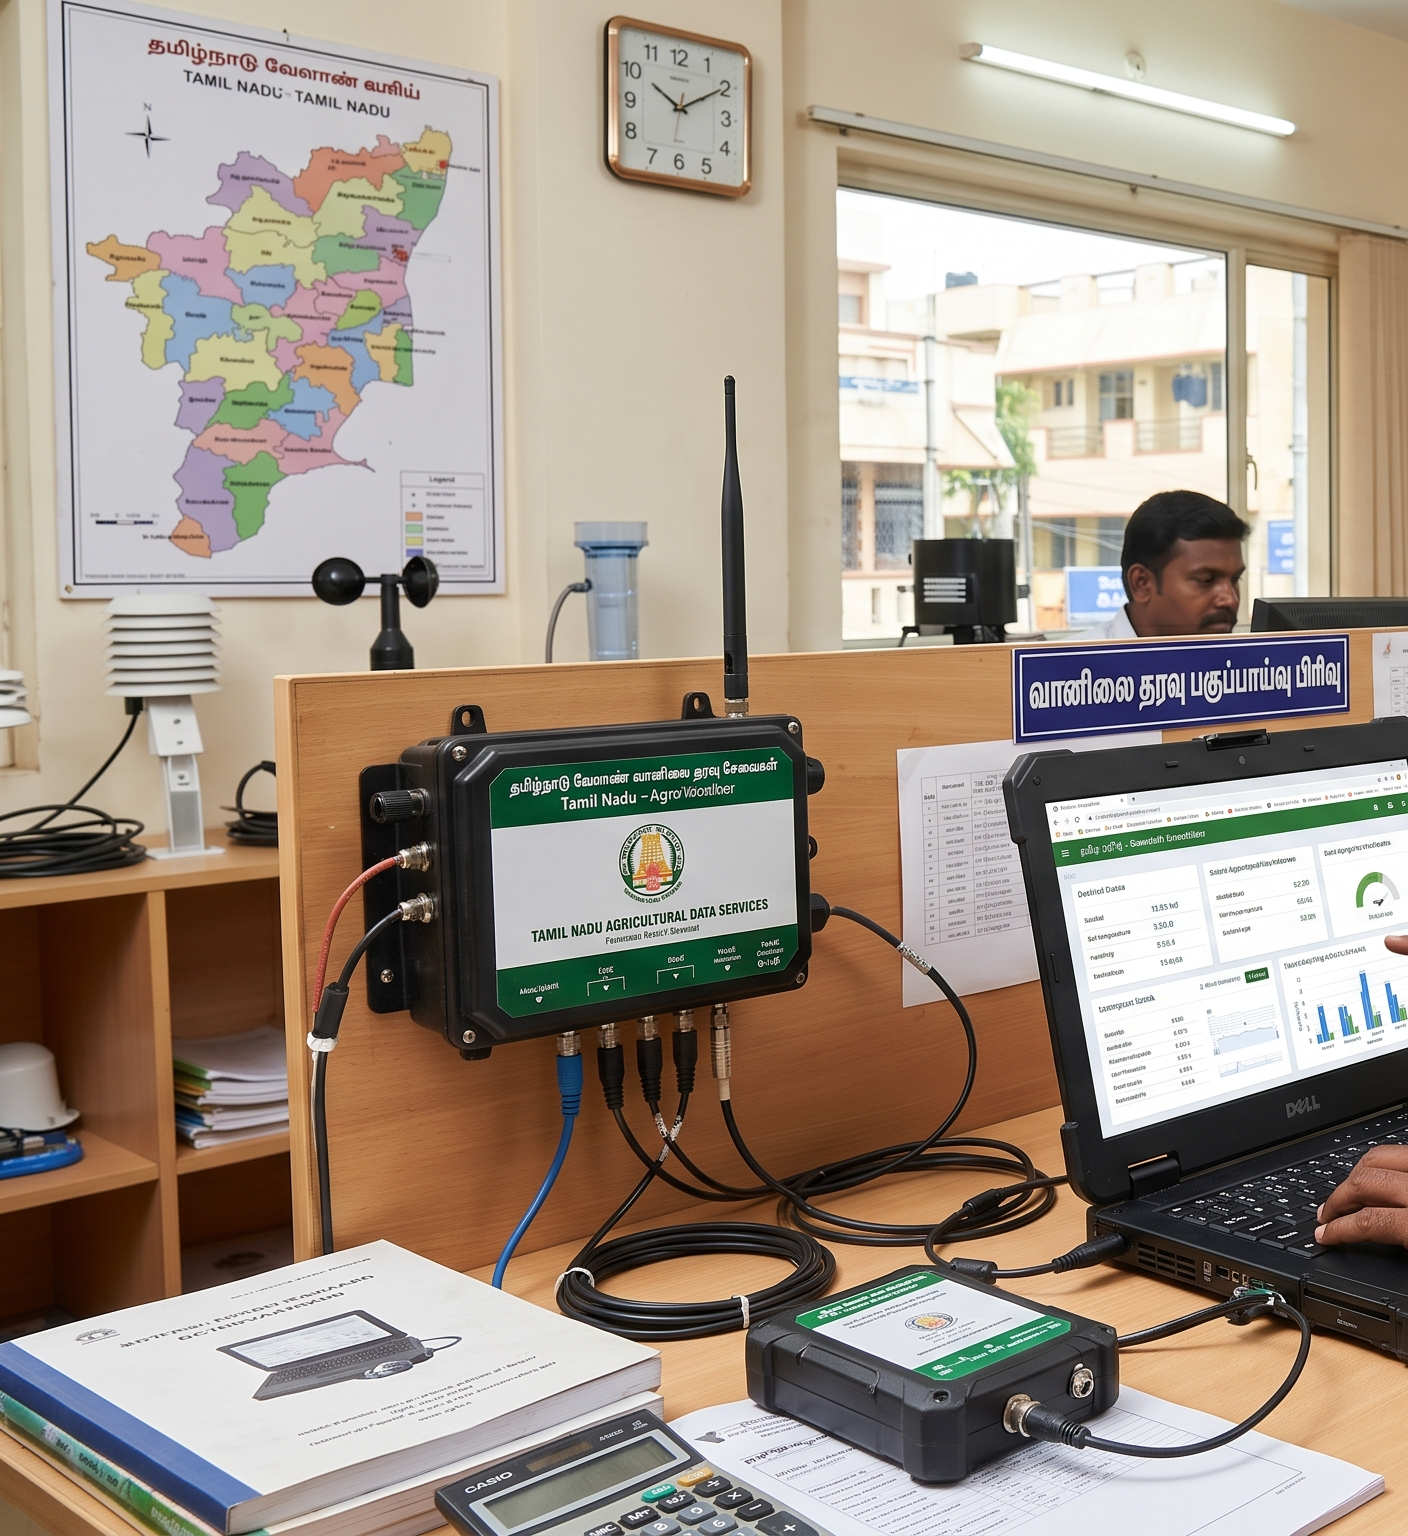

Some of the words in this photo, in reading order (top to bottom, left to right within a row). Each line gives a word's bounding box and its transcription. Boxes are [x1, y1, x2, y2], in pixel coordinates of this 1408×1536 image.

[148, 38, 258, 72] தமிழ்நாடு
[644, 44, 658, 62] 11
[670, 48, 689, 68] 12
[622, 60, 642, 79] 10
[703, 57, 710, 73] 1
[183, 69, 232, 91] TAMIL
[295, 90, 342, 110] TAMIL
[347, 99, 391, 118] NADU
[719, 80, 731, 98] 2
[624, 91, 636, 108] 9
[720, 110, 732, 128] 3
[625, 122, 637, 139] 8
[646, 147, 658, 165] 7
[719, 141, 731, 156] 4
[673, 153, 685, 170] 6
[701, 157, 712, 175] 5
[1029, 668, 1135, 710] வானிலை
[1139, 672, 1186, 711] தரவு
[1190, 657, 1292, 703] பகுப்பாய்வு
[1296, 654, 1341, 693] பிரிவு
[561, 793, 598, 811] Tamil
[602, 790, 637, 807] Nadu
[531, 926, 568, 943] TAMIL
[571, 921, 603, 937] NADU
[605, 909, 688, 933] AGRICULTURAL
[690, 905, 717, 920] DATA
[719, 898, 769, 917] SERVICES
[1285, 1095, 1320, 1118] DELL
[464, 1471, 513, 1494] CASIO
